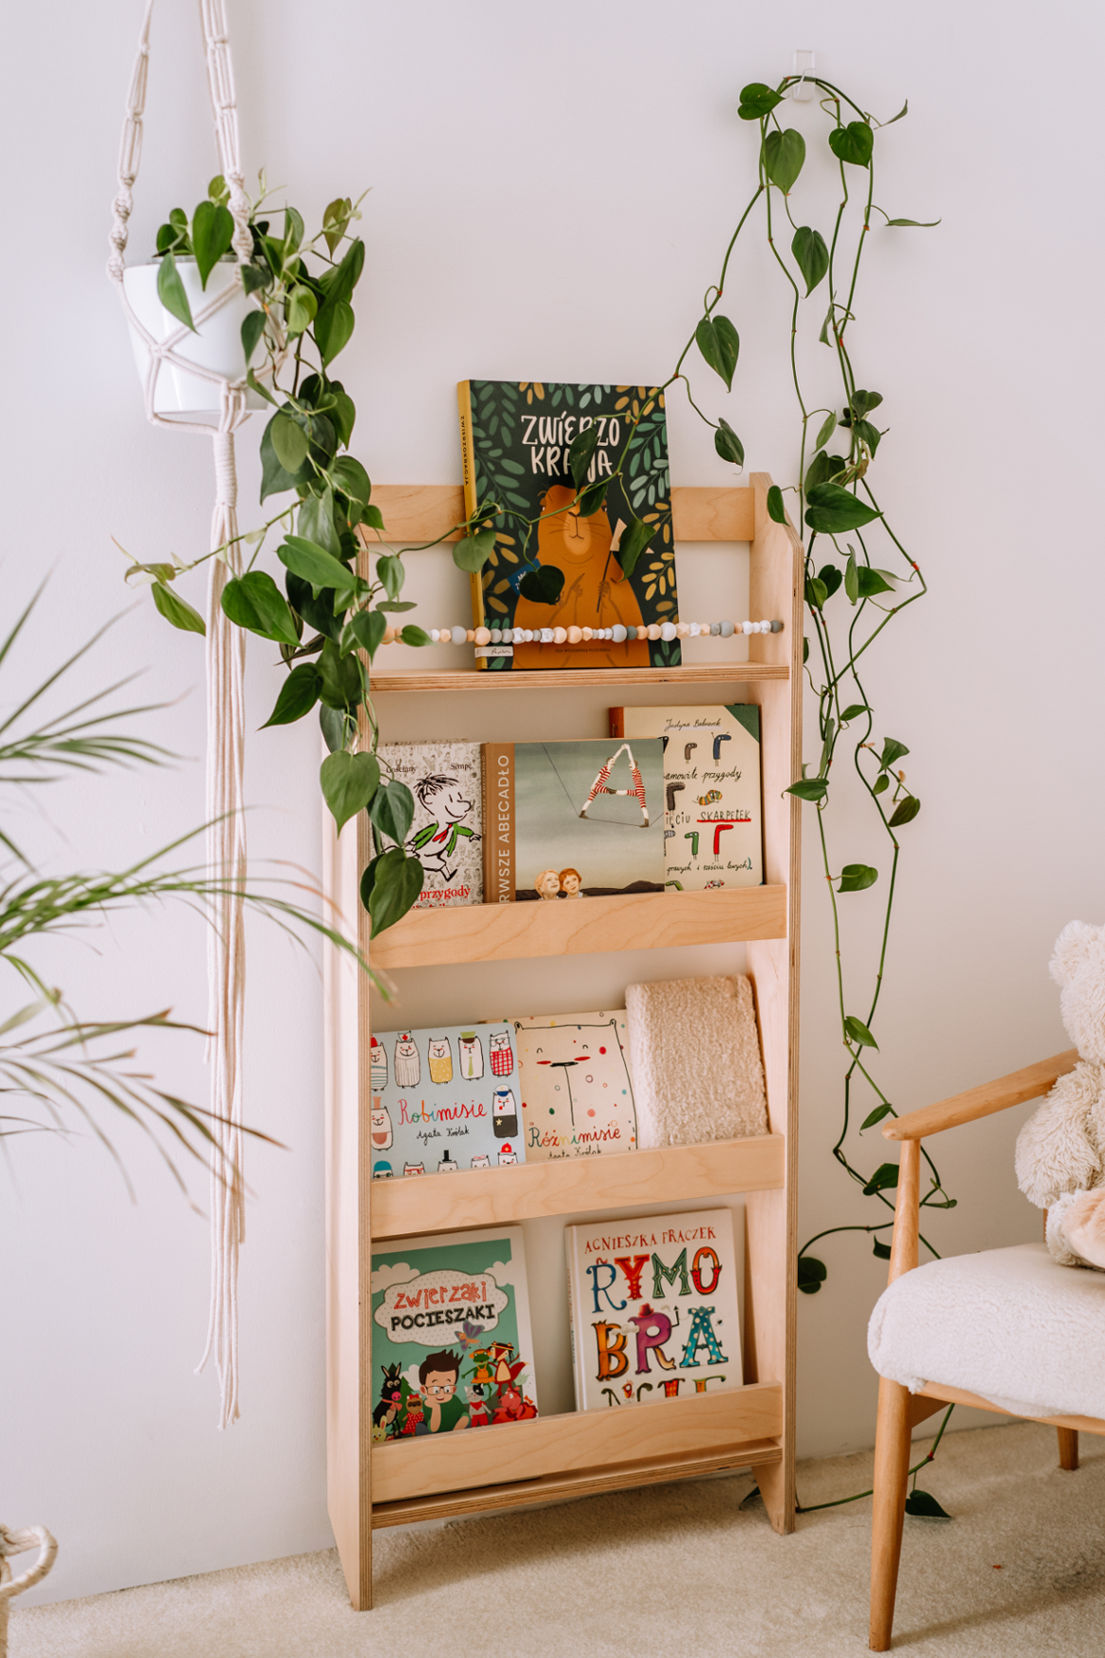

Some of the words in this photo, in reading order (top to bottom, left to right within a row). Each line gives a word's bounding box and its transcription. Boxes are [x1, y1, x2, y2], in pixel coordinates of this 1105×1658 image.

[701, 766, 742, 784] przygody
[497, 755, 510, 843] ABECADŁO
[420, 884, 471, 901] przygody
[398, 1098, 487, 1126] Robimisie
[528, 1126, 621, 1148] Różnimisie
[584, 1233, 657, 1254] AGNIESZKA
[586, 1247, 723, 1313] RYMO
[391, 1304, 495, 1331] POCIESZAKI
[591, 1305, 729, 1382] BRA
